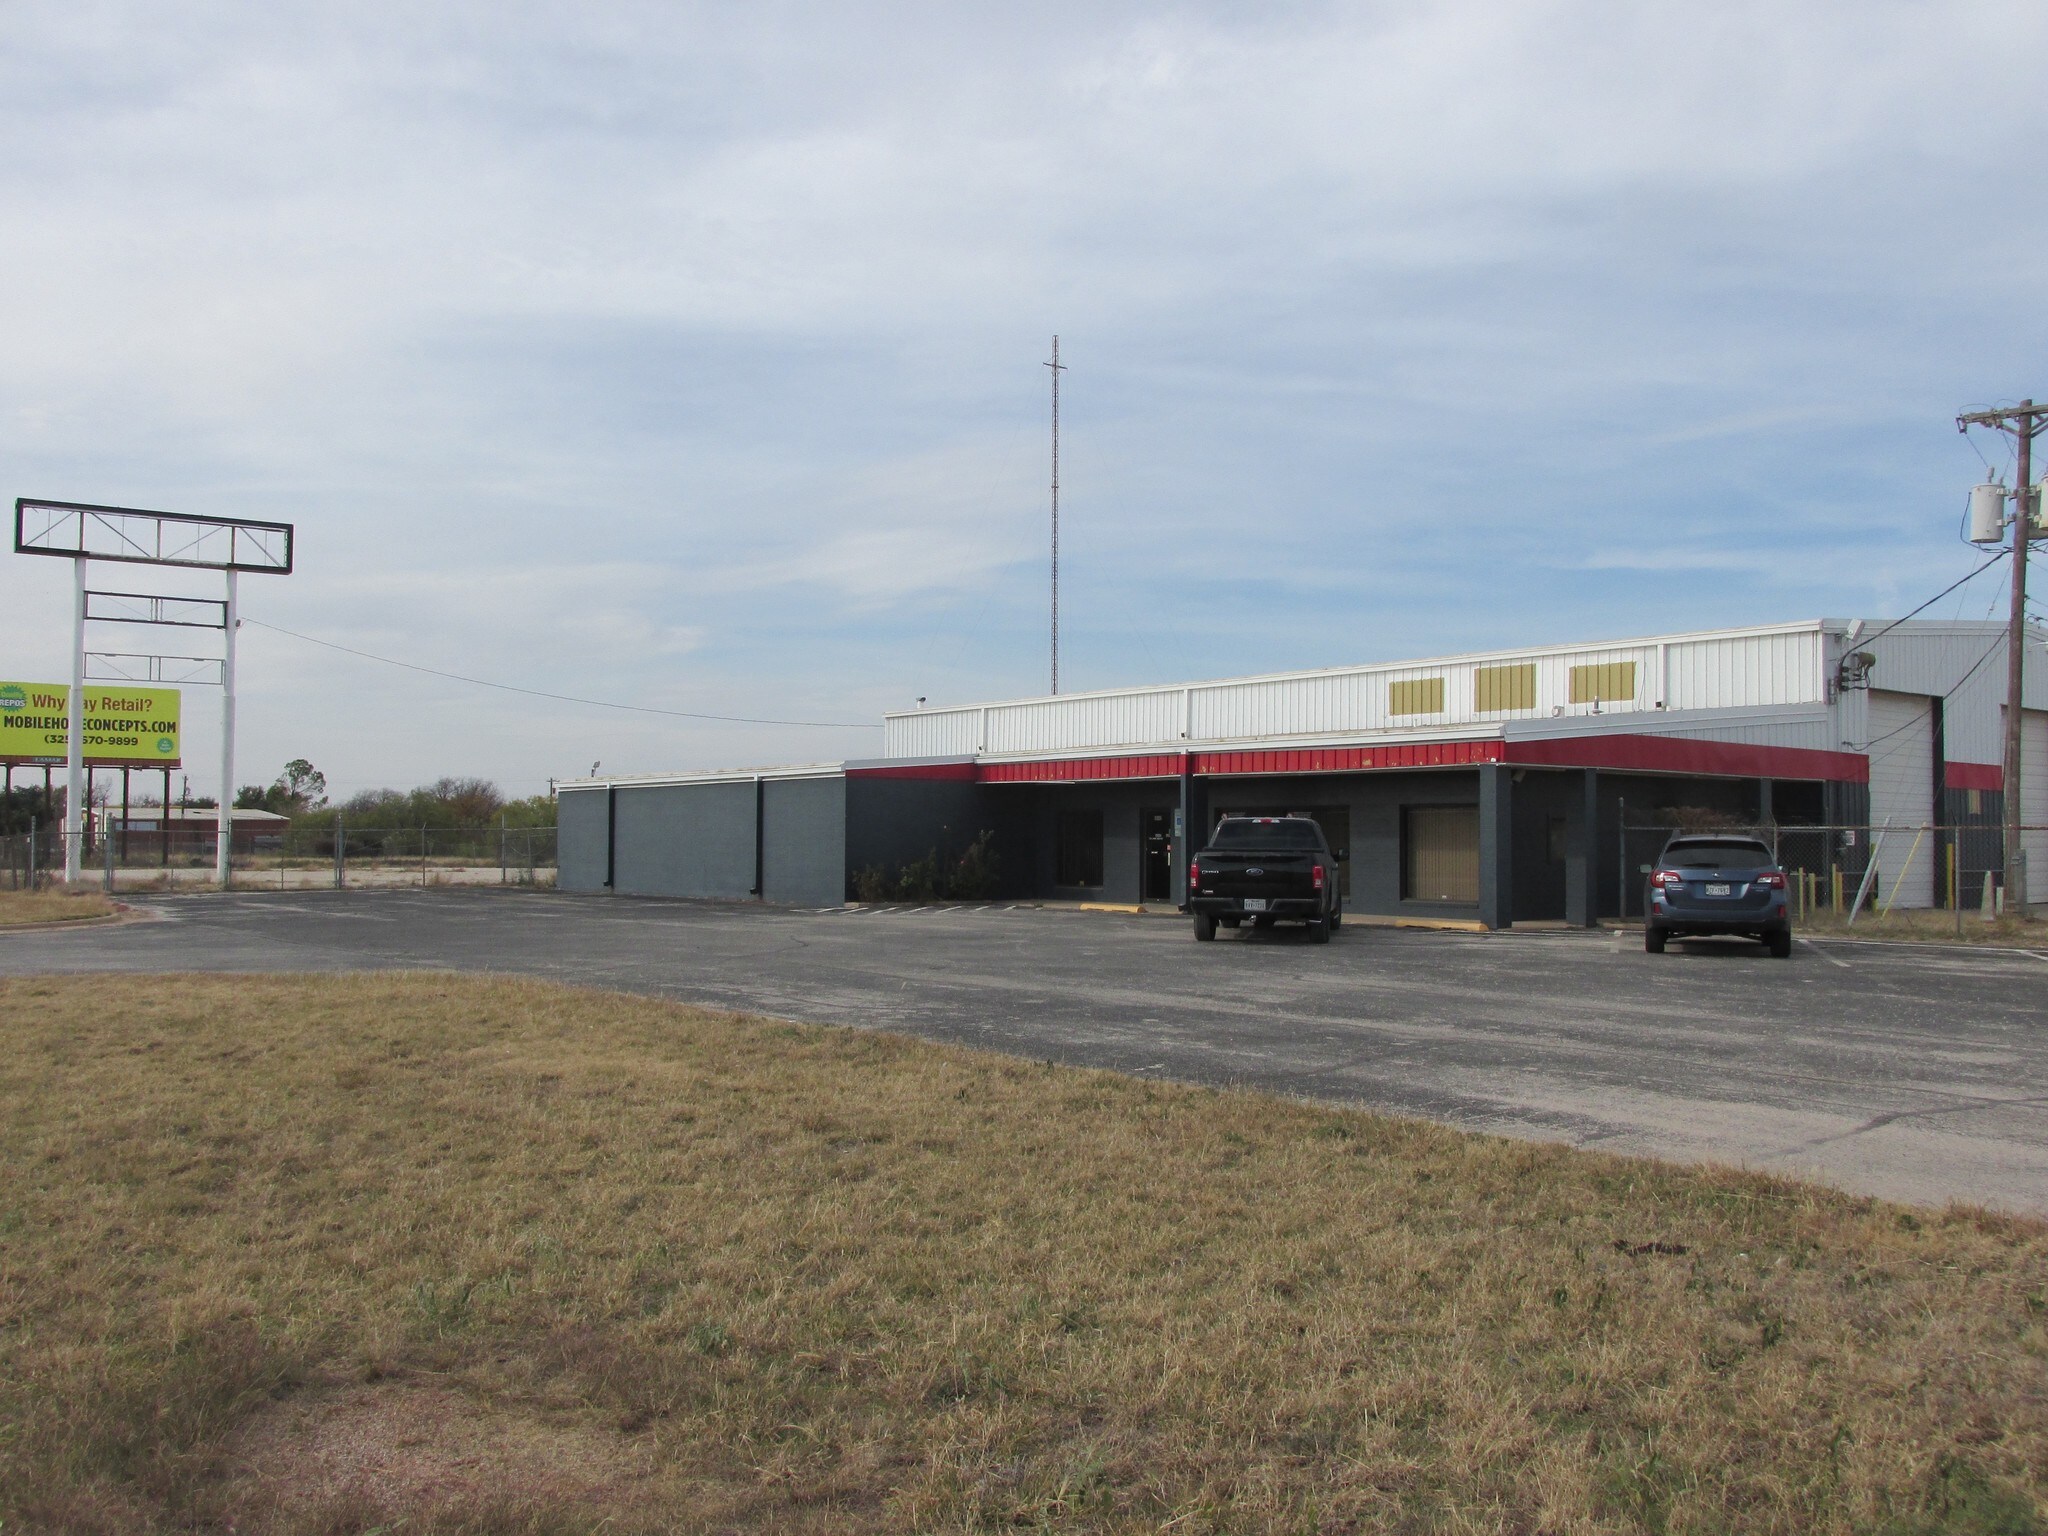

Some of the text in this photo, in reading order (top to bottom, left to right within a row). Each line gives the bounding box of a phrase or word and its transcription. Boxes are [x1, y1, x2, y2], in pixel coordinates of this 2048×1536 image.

[0, 699, 26, 707] REPOS
[32, 694, 66, 710] Why
[83, 698, 97, 713] ay
[102, 697, 153, 712] Retail?
[4, 715, 177, 733] MOBILEHOECONCEPTS.COM
